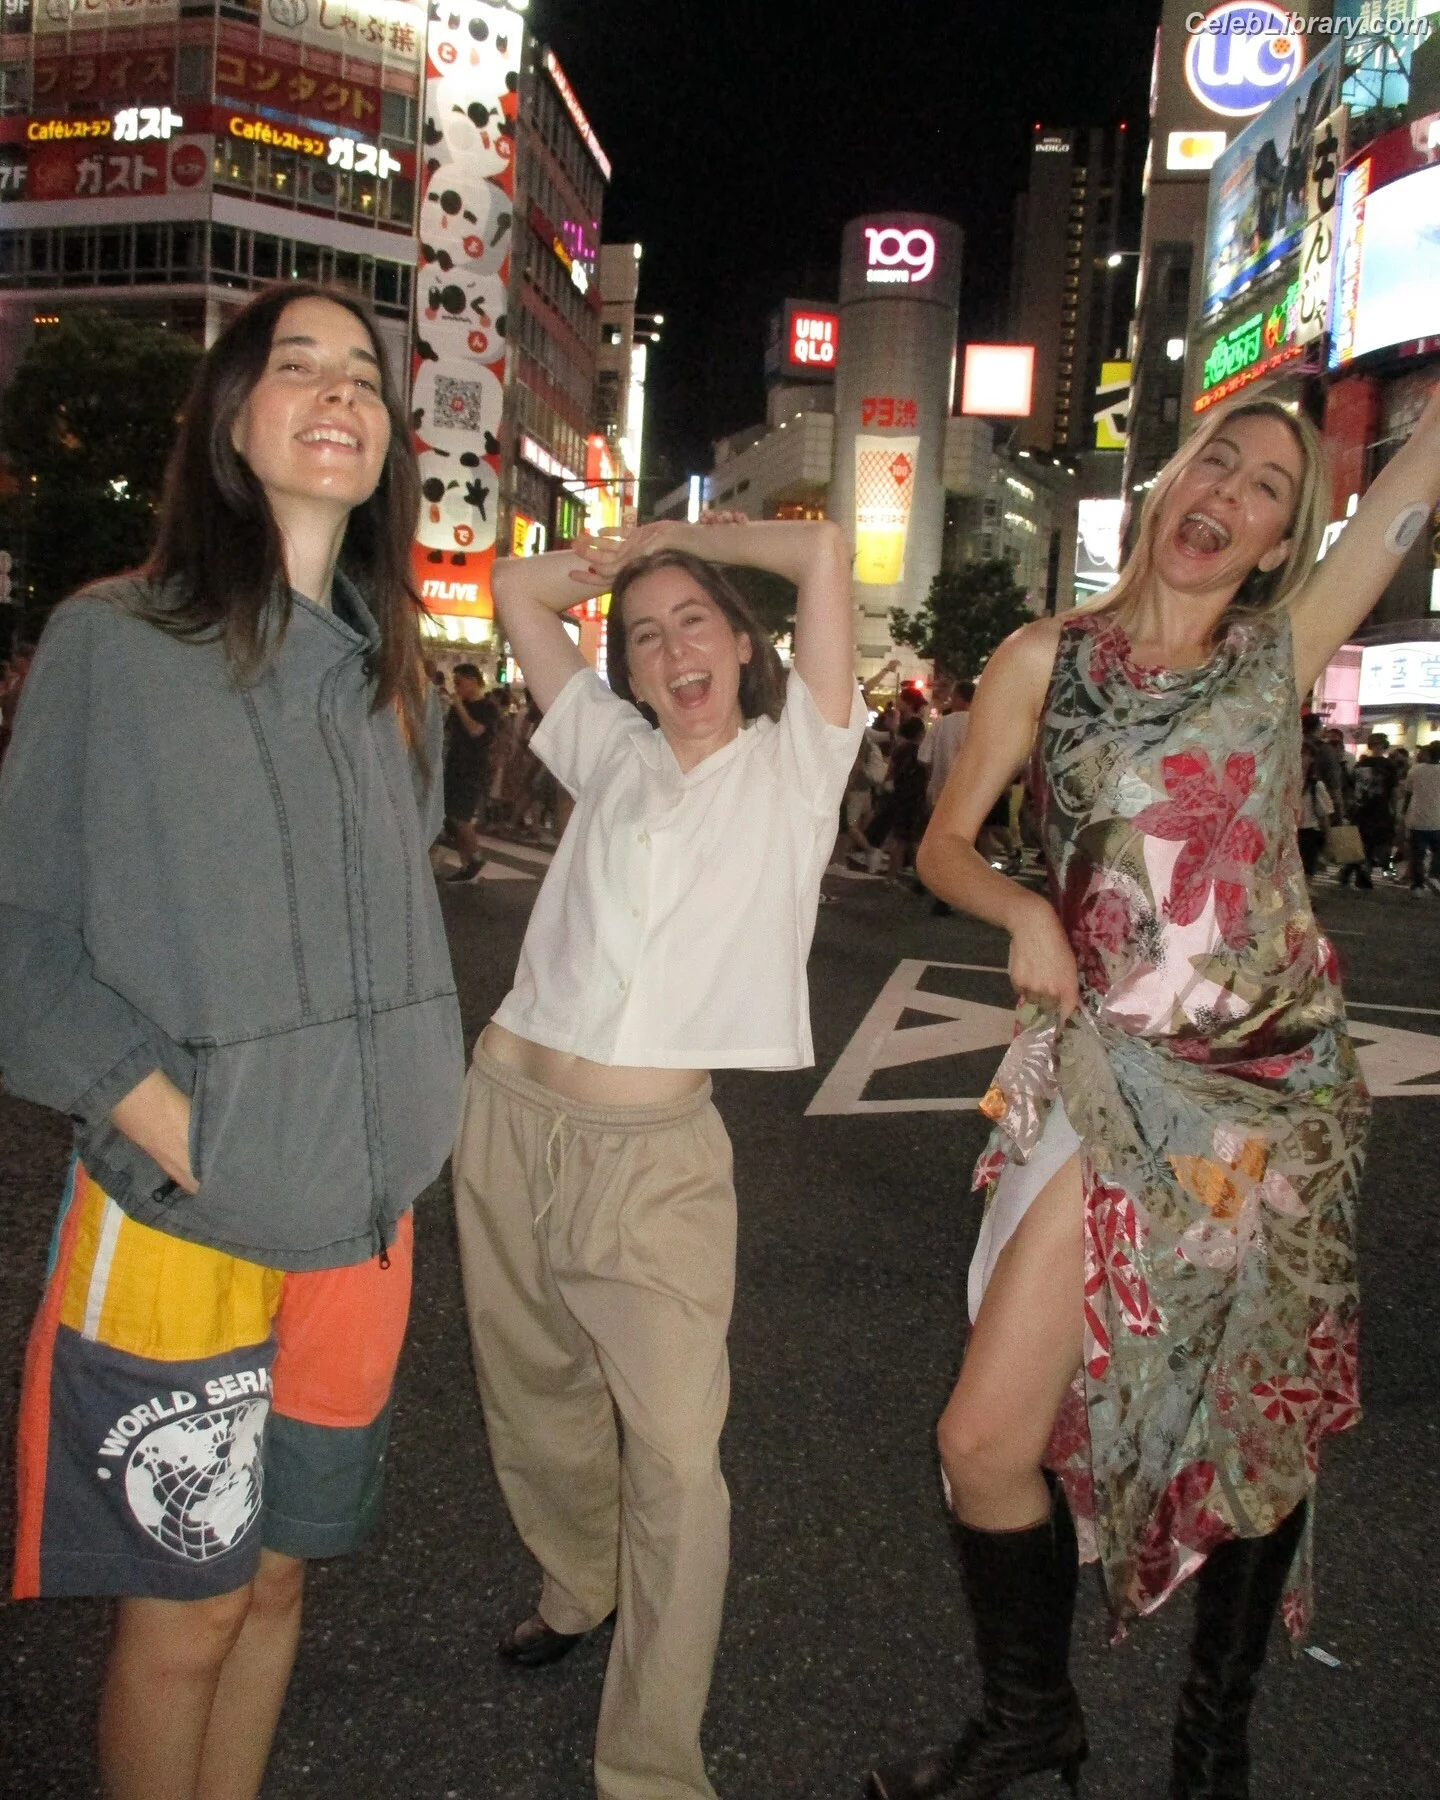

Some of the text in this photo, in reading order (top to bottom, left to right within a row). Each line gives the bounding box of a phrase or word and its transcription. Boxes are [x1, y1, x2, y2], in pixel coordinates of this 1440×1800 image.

[319, 0, 415, 51] しゃぶ葉
[216, 54, 376, 119] コンタクト
[113, 107, 183, 141] ガスト
[0, 166, 28, 189] 7F
[75, 154, 158, 194] ガスト
[327, 137, 401, 179] ガスト
[864, 227, 936, 283] 109
[422, 579, 479, 603] 17LIVE
[98, 1367, 274, 1460] WORLD SERI
